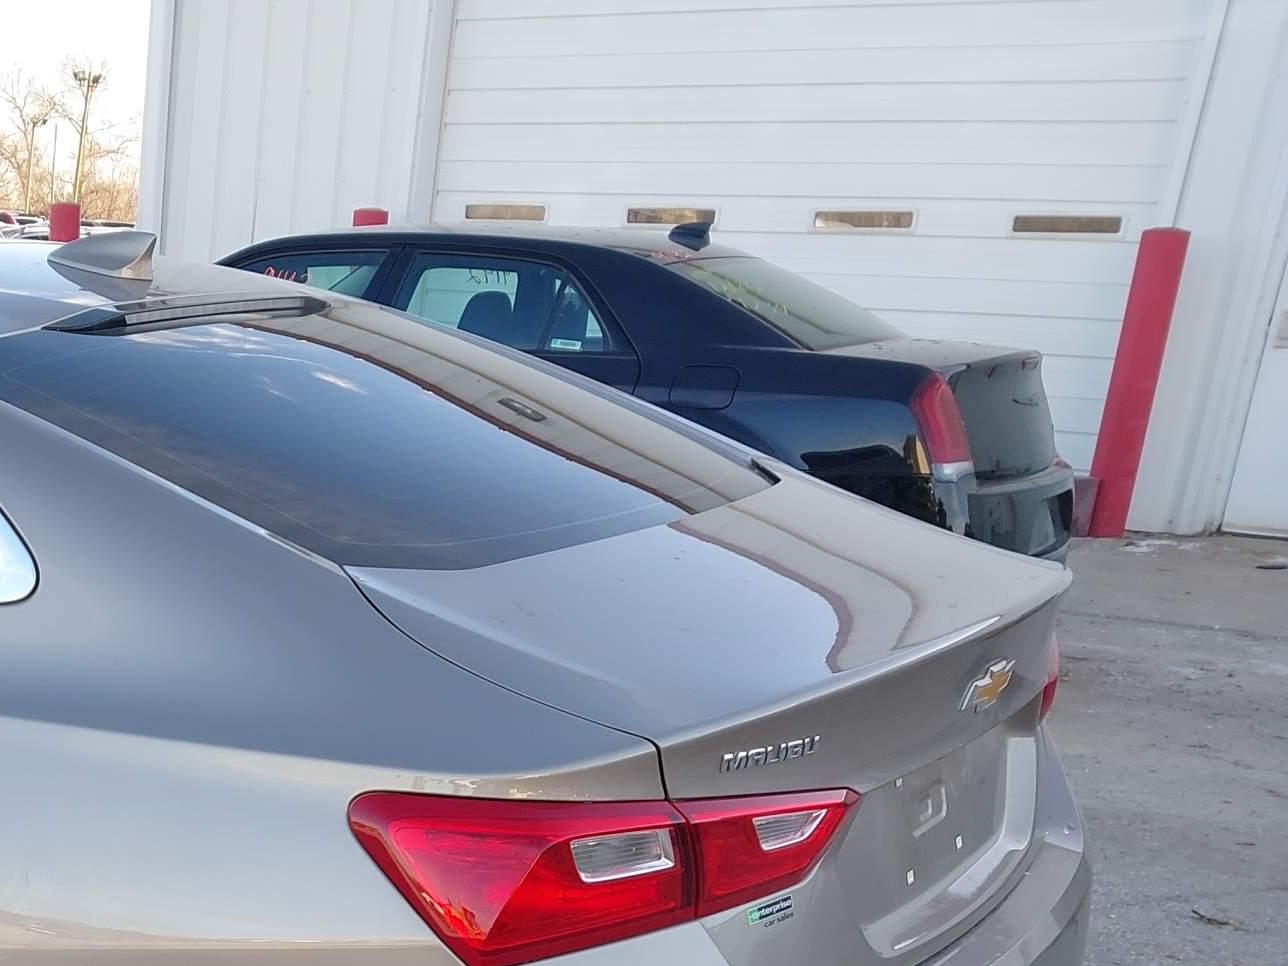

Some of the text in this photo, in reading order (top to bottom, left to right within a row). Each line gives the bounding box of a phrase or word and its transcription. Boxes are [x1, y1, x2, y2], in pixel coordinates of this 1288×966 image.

[719, 735, 821, 773] MALIBU
[751, 899, 792, 919] enterprise
[764, 919, 776, 928] car
